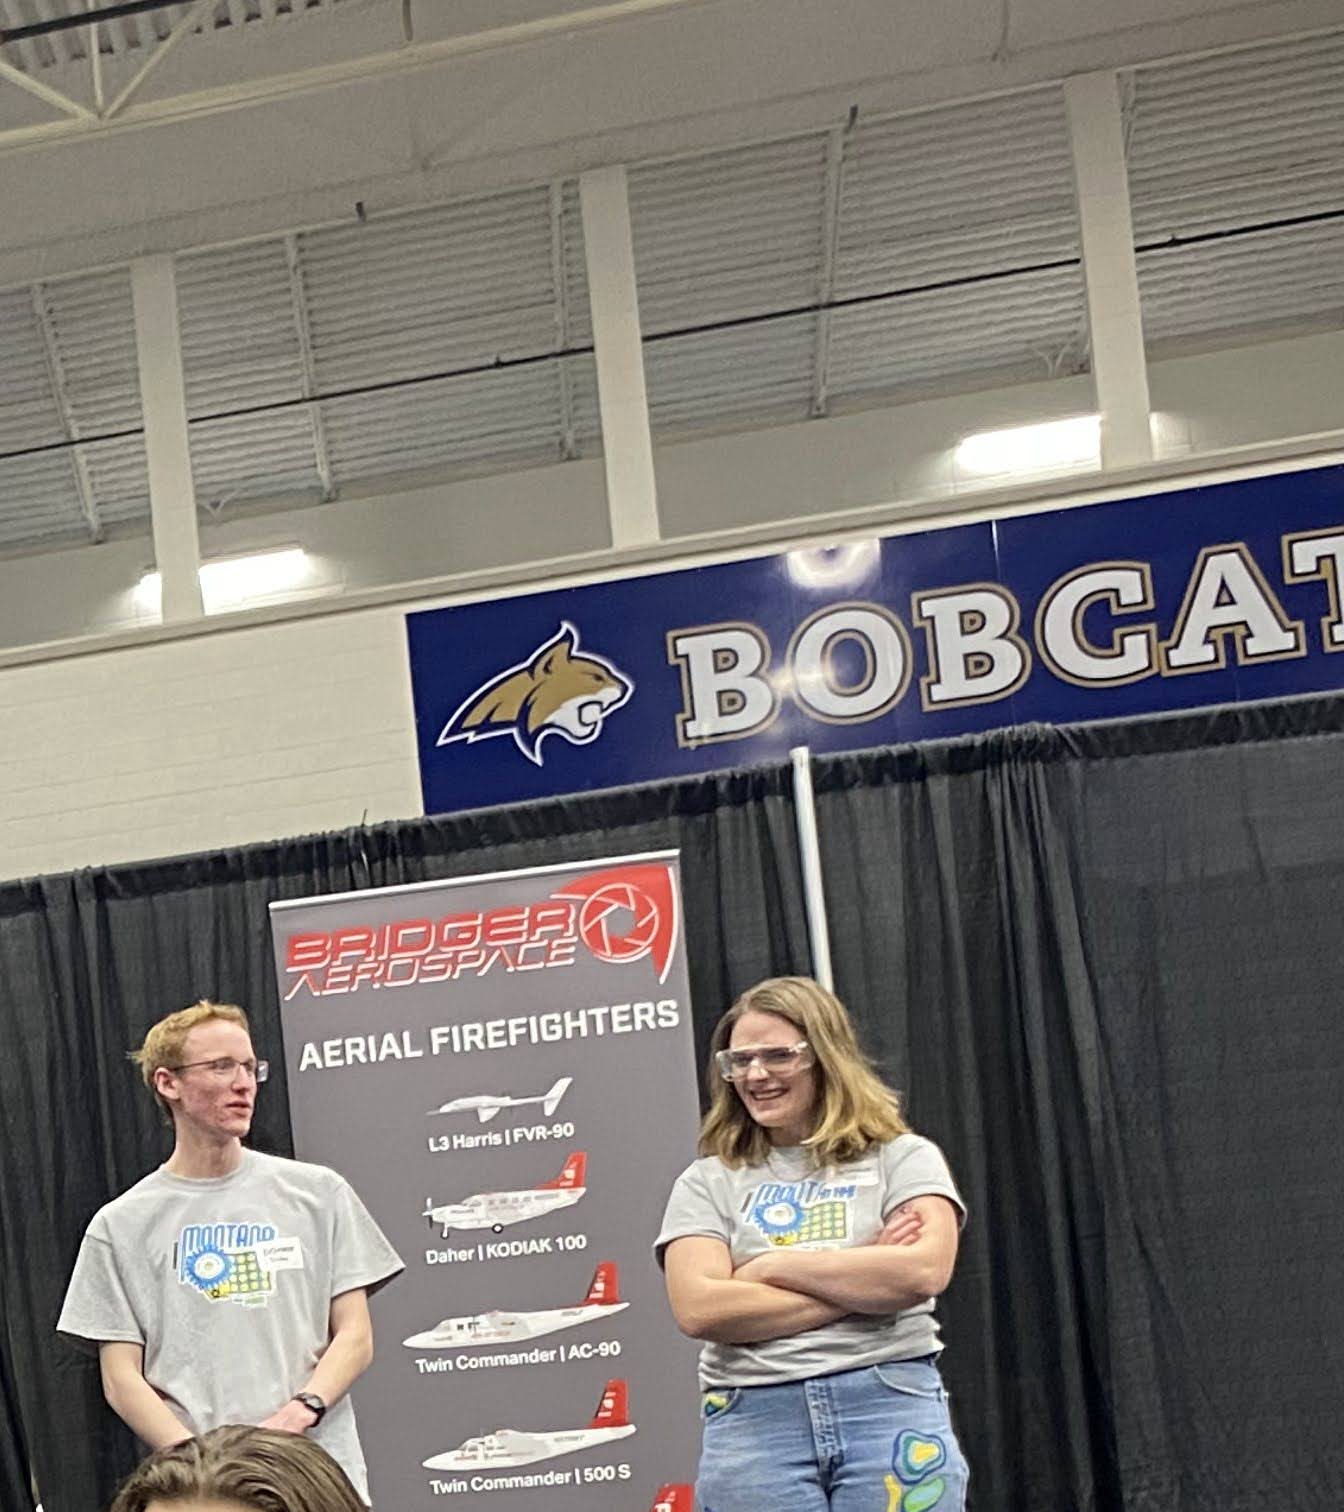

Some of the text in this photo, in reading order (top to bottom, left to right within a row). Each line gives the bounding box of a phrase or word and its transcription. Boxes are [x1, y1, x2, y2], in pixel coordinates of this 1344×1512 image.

[285, 901, 580, 974] BRIDGER
[283, 936, 577, 1001] AEROSPACE
[299, 999, 680, 1072] AERIAL FIREFIGHTERS
[428, 1122, 575, 1153] L3 Harris FVR-90
[425, 1234, 587, 1265] Daher KODIAK 100
[415, 1341, 622, 1374] Twin Commander AC-90
[429, 1463, 632, 1495] Twin Commander 500 S
